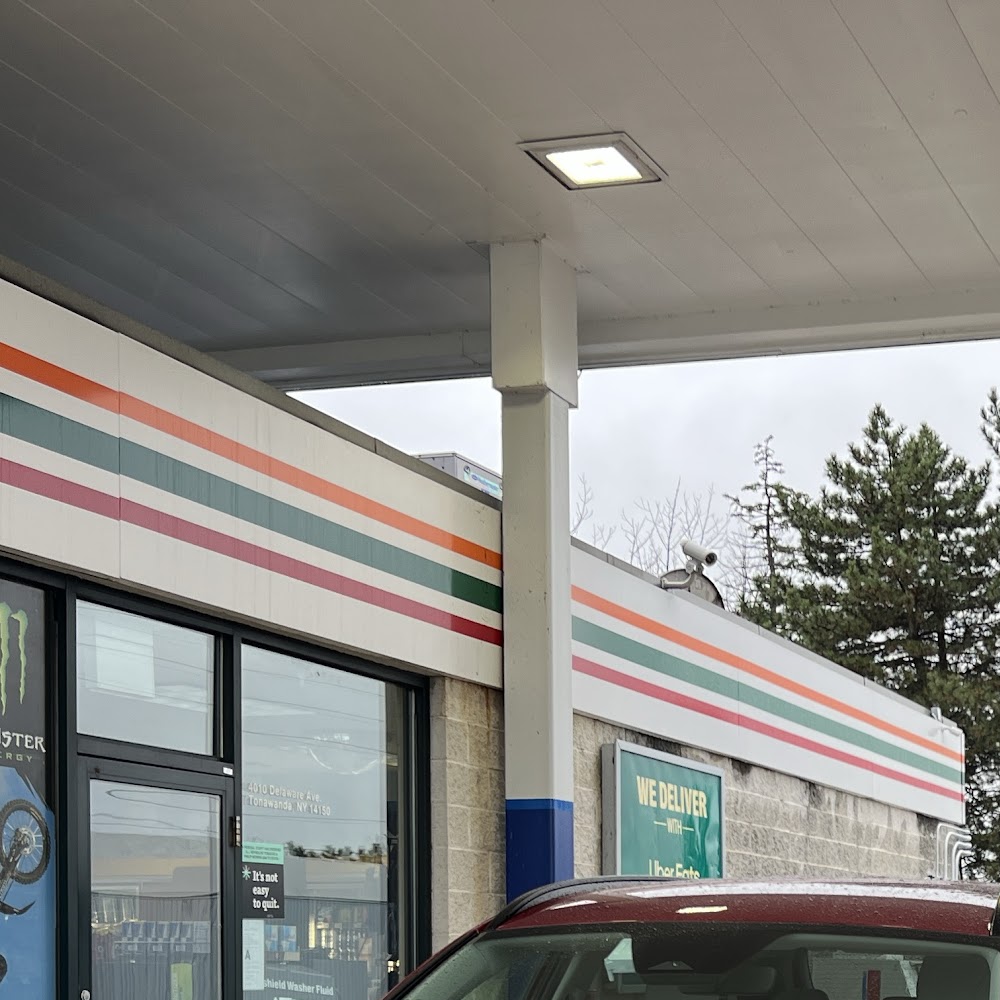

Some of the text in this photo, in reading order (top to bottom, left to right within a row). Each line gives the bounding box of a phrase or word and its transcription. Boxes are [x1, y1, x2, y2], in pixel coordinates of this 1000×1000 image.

[0, 730, 46, 753] STER
[248, 782, 322, 803] 4010 Delaware Ave.
[636, 775, 708, 818] WE DELIVER
[296, 800, 308, 813] NY
[309, 803, 331, 816] 14150
[666, 817, 683, 835] WITH
[252, 870, 279, 883] It's not
[252, 886, 270, 898] easy
[252, 897, 280, 912] to quit.
[287, 980, 315, 994] Washer
[316, 984, 334, 996] Fluid
